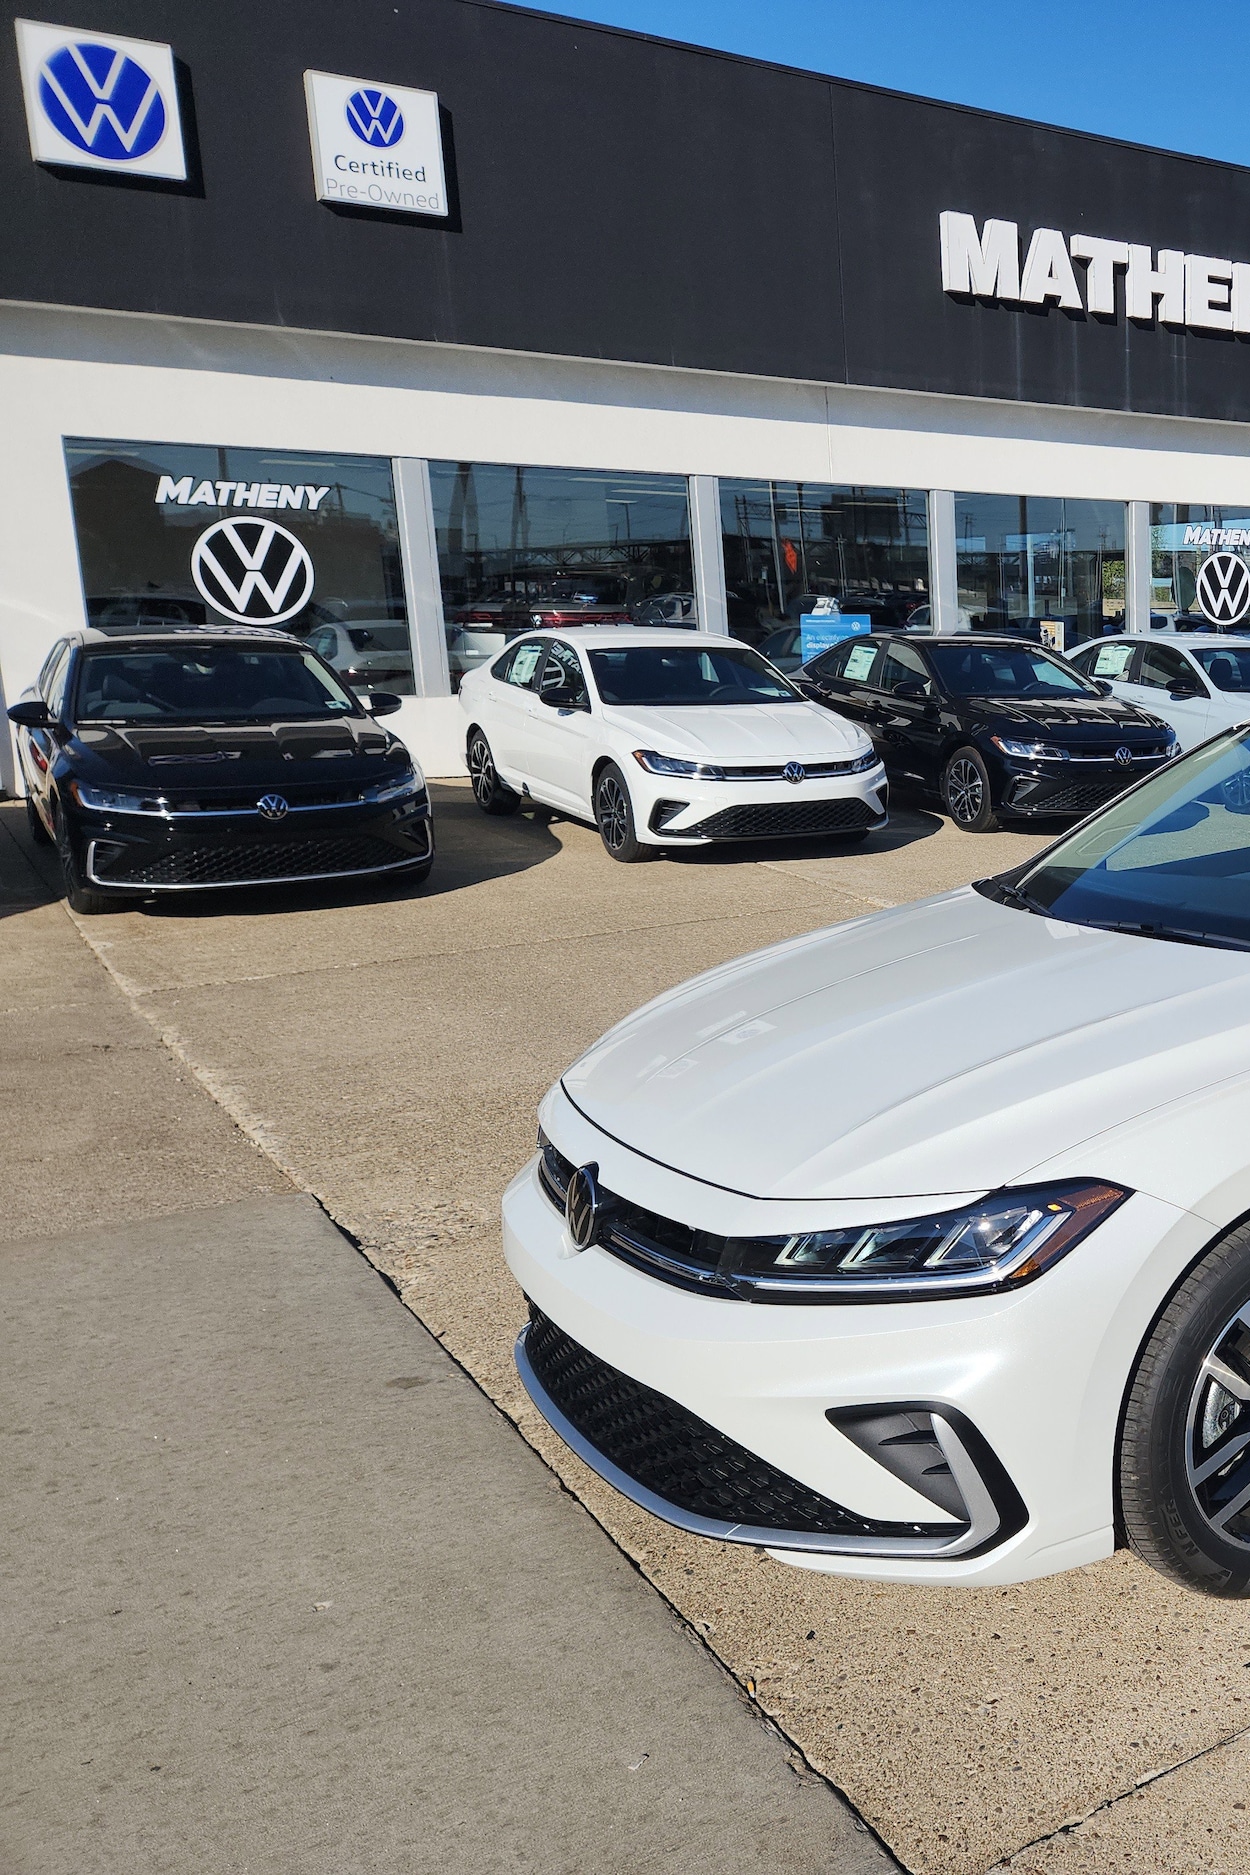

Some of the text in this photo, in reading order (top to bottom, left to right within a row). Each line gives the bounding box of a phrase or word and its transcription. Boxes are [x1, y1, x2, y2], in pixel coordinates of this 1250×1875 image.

[334, 154, 426, 182] Certified
[326, 178, 440, 209] Pre-Owned
[155, 475, 331, 511] MATHENY
[806, 641, 829, 650] display
